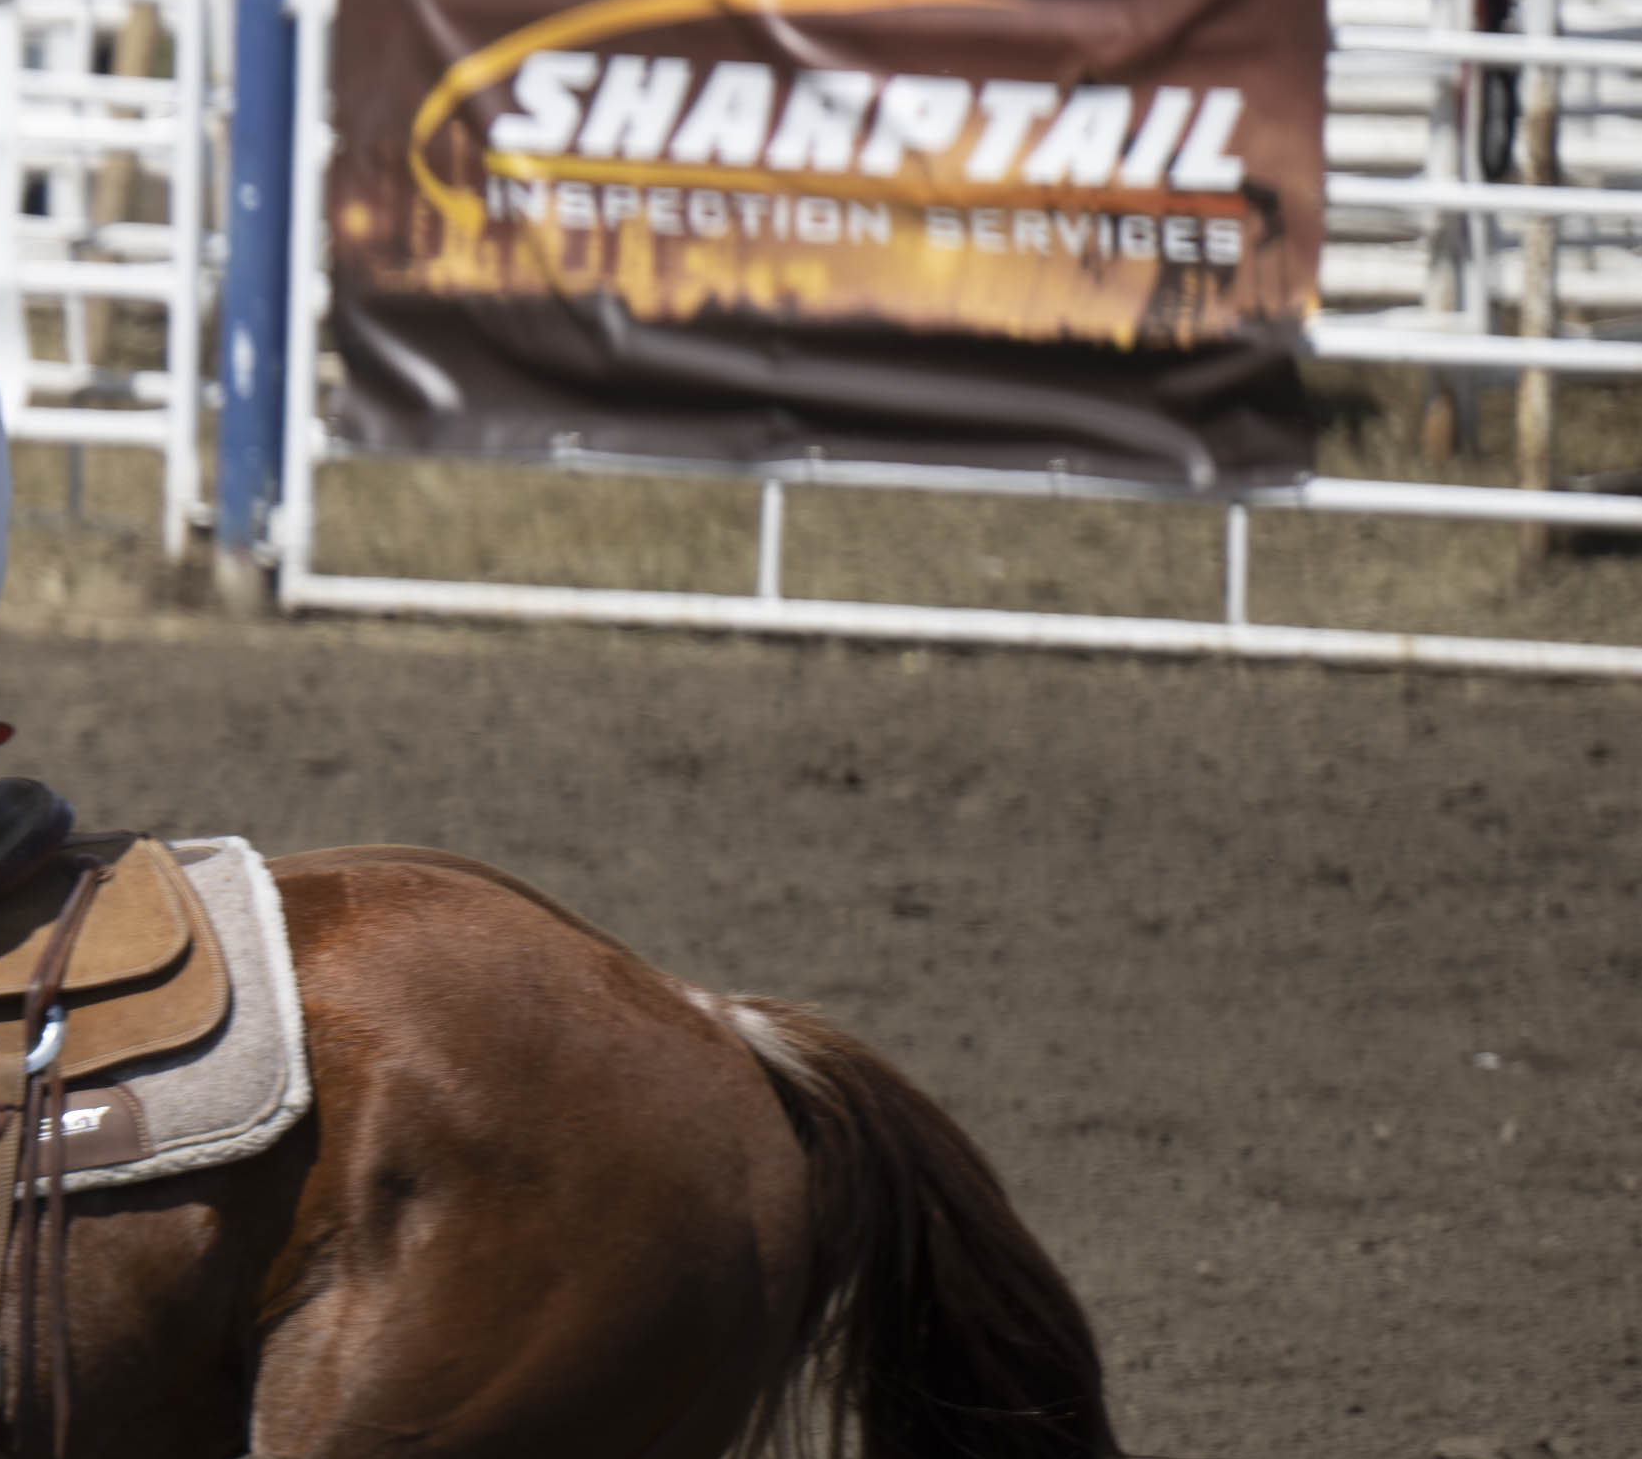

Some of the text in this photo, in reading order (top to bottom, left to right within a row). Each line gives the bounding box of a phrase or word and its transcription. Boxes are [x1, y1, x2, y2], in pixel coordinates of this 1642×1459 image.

[489, 50, 1247, 193] SHARPTAIL
[485, 179, 1244, 267] INSPECTION SERVICES
